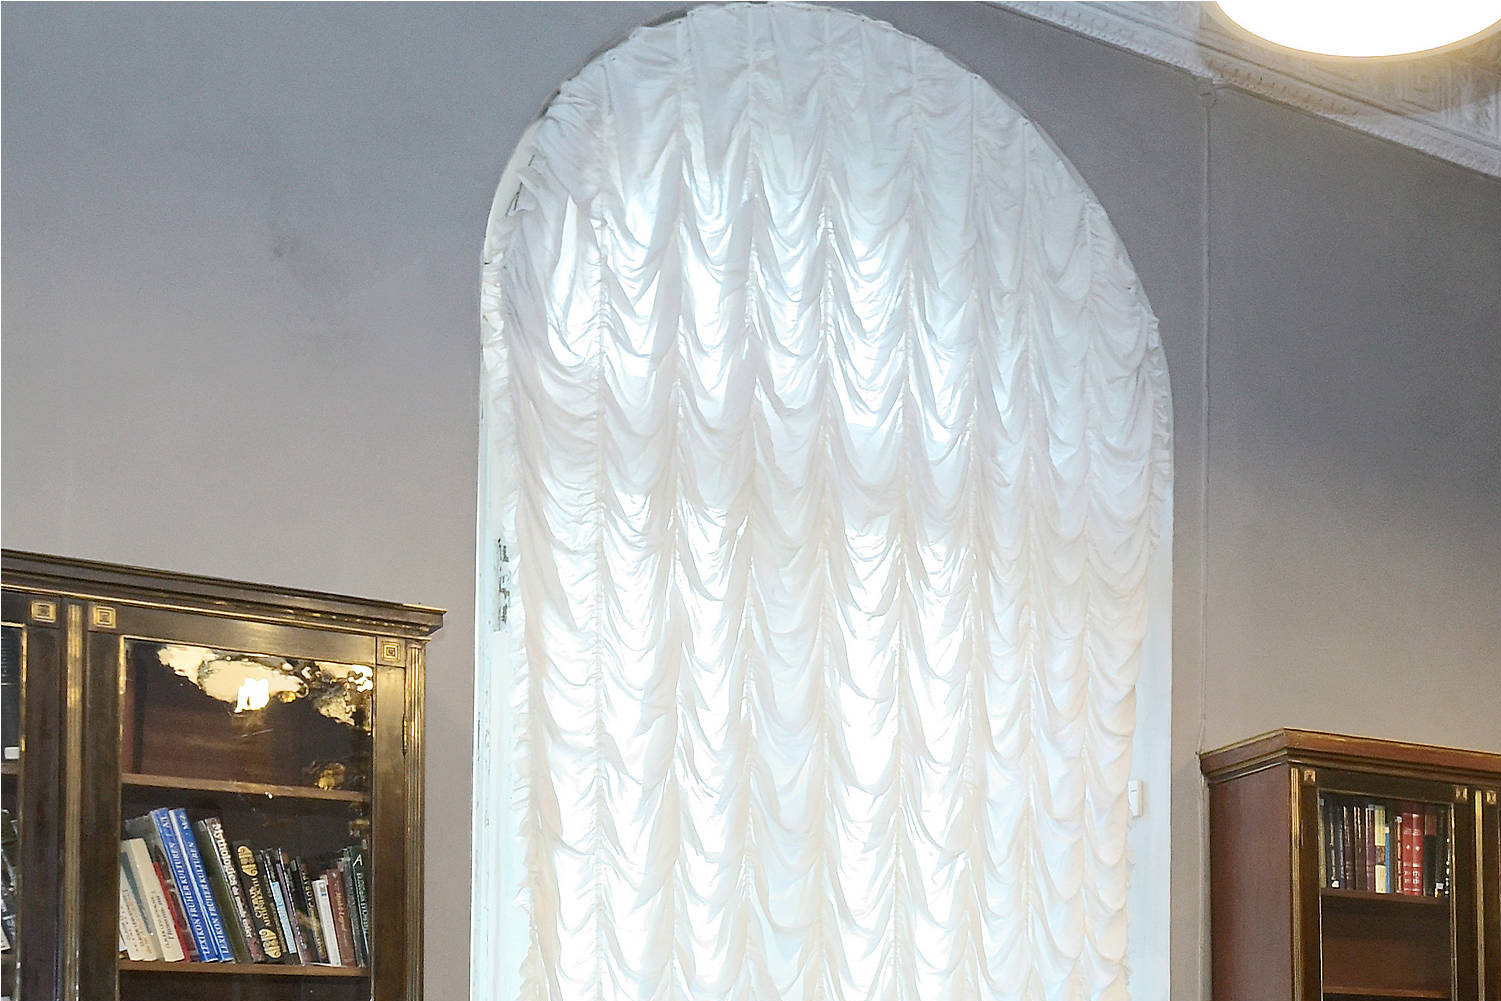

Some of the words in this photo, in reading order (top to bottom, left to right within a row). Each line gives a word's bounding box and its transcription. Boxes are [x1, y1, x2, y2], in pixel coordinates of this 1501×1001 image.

[210, 821, 238, 886] Mythologies
[192, 917, 210, 955] LEXIKON
[211, 917, 229, 954] LEXIKON
